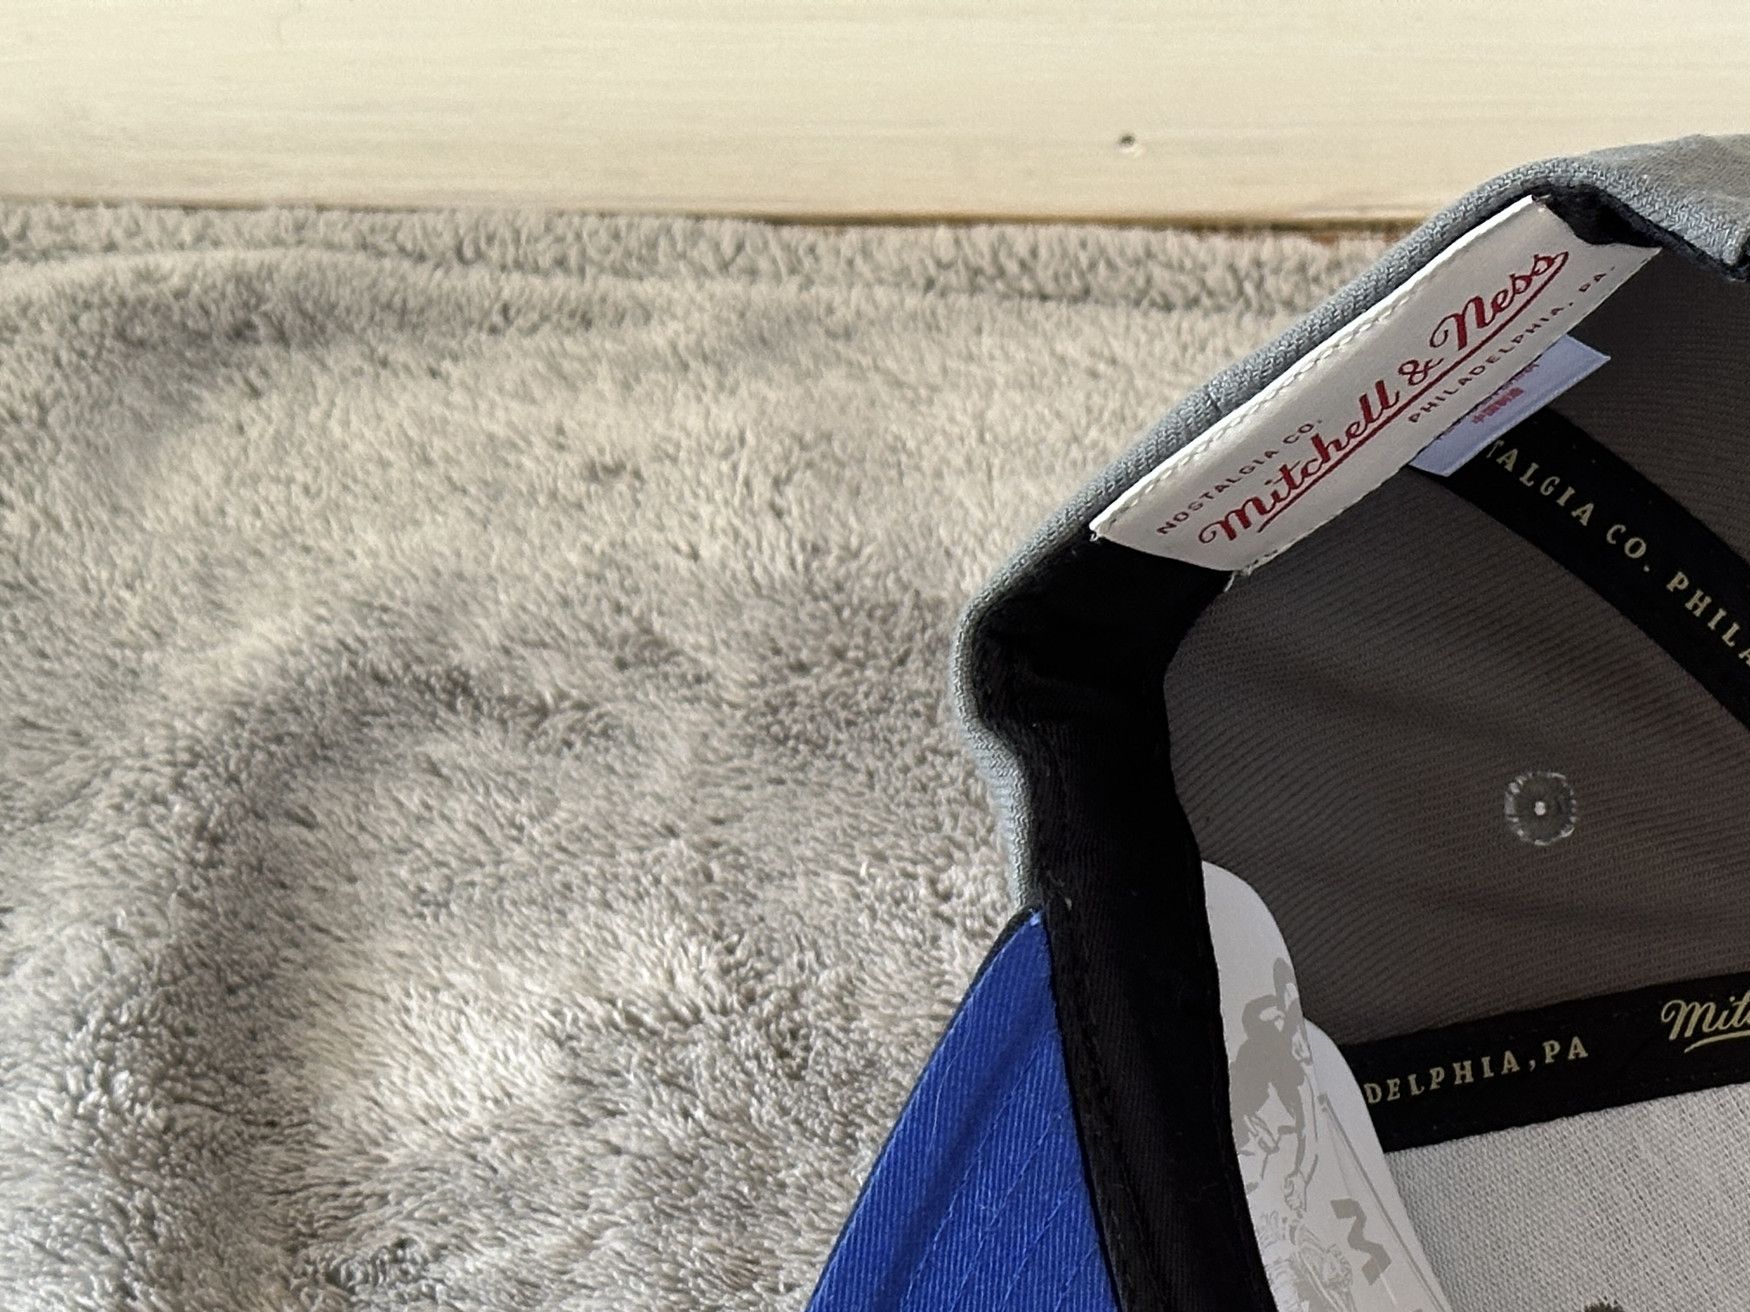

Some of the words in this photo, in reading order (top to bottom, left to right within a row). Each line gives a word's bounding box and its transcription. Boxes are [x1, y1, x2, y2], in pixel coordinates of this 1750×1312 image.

[1198, 380, 1401, 542] Mitchell
[1398, 355, 1445, 387] &
[1429, 251, 1570, 350] Ness
[1157, 447, 1280, 536] NOSTALGIA
[1283, 418, 1325, 451] CO.
[1606, 524, 1651, 573] CO.
